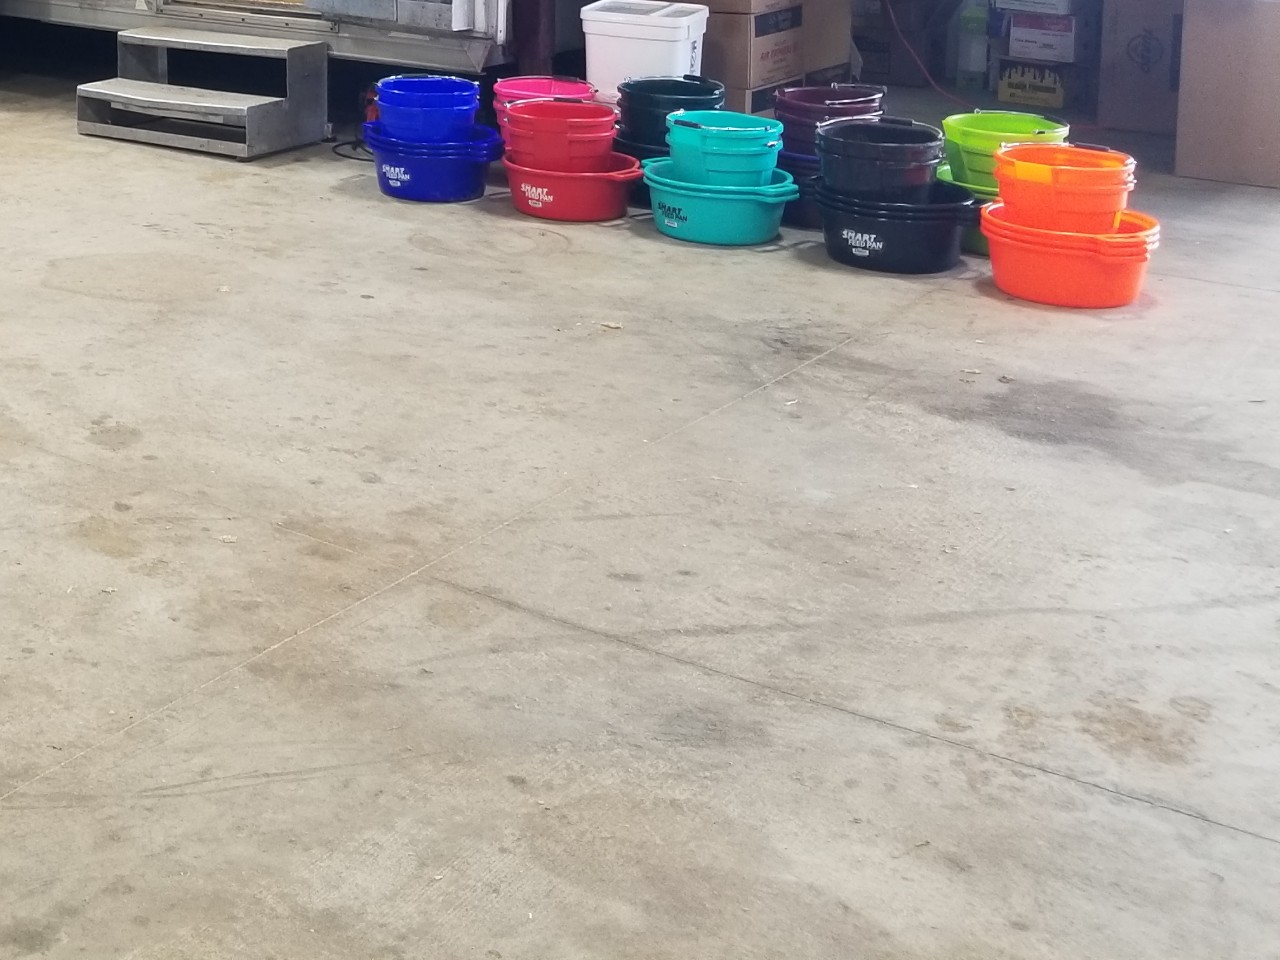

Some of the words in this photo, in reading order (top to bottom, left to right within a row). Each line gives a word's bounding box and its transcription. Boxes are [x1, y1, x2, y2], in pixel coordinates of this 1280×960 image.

[521, 183, 548, 195] SMART
[540, 193, 554, 202] PAN
[658, 202, 682, 215] SMART
[842, 229, 876, 242] SMART
[848, 239, 865, 248] FEED
[866, 241, 883, 249] PAN
